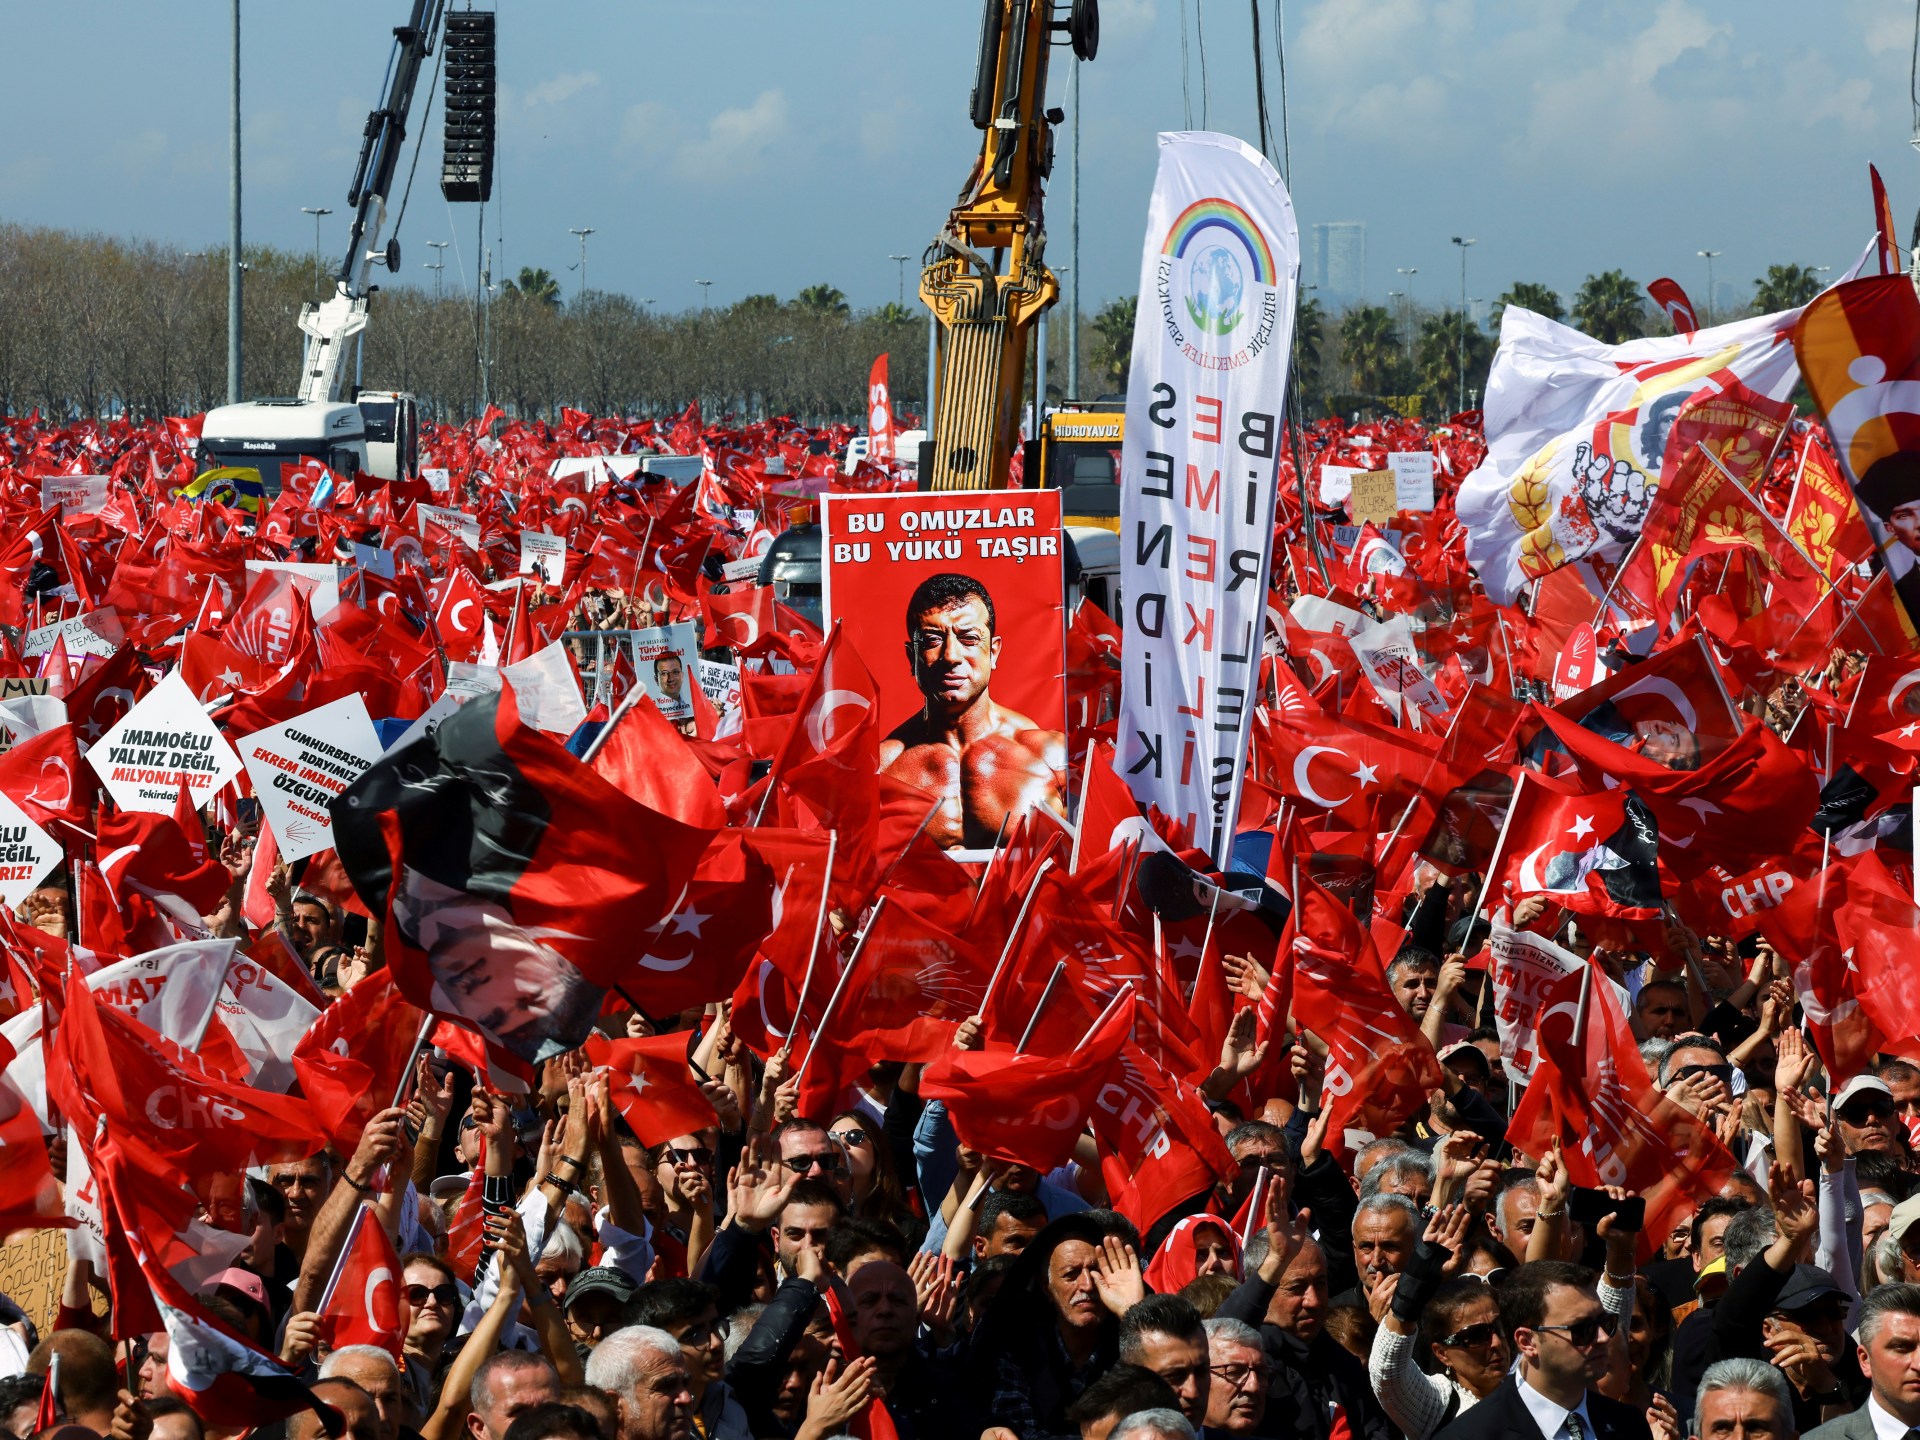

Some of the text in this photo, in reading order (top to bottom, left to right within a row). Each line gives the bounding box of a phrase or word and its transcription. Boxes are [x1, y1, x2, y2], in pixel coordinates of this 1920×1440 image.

[51, 489, 91, 499] TAM YOL
[63, 498, 84, 507] LERİ
[847, 506, 1036, 534] BU OMUZLAR
[834, 529, 1058, 564] BU YÜKÜ TAŞIR
[638, 645, 669, 655] Türkiye
[1568, 664, 1581, 680] CHP
[121, 728, 213, 752] İMAMOĞLU
[284, 727, 373, 772] CUMHURBAŞKA
[108, 747, 222, 775] YALNIZ DEĞİL,
[252, 747, 348, 796] EKREM İMAMO
[298, 750, 359, 783] ADAYIMIZ
[111, 767, 213, 789] MİLYONLARIZ!
[138, 788, 179, 804] Tekirdağ
[286, 799, 331, 828] Tekirdağ
[0, 826, 27, 843] LU
[1721, 871, 1794, 919] CHP
[230, 961, 273, 993] OL
[144, 1084, 246, 1130] CHP
[1096, 1082, 1171, 1160] CHP
